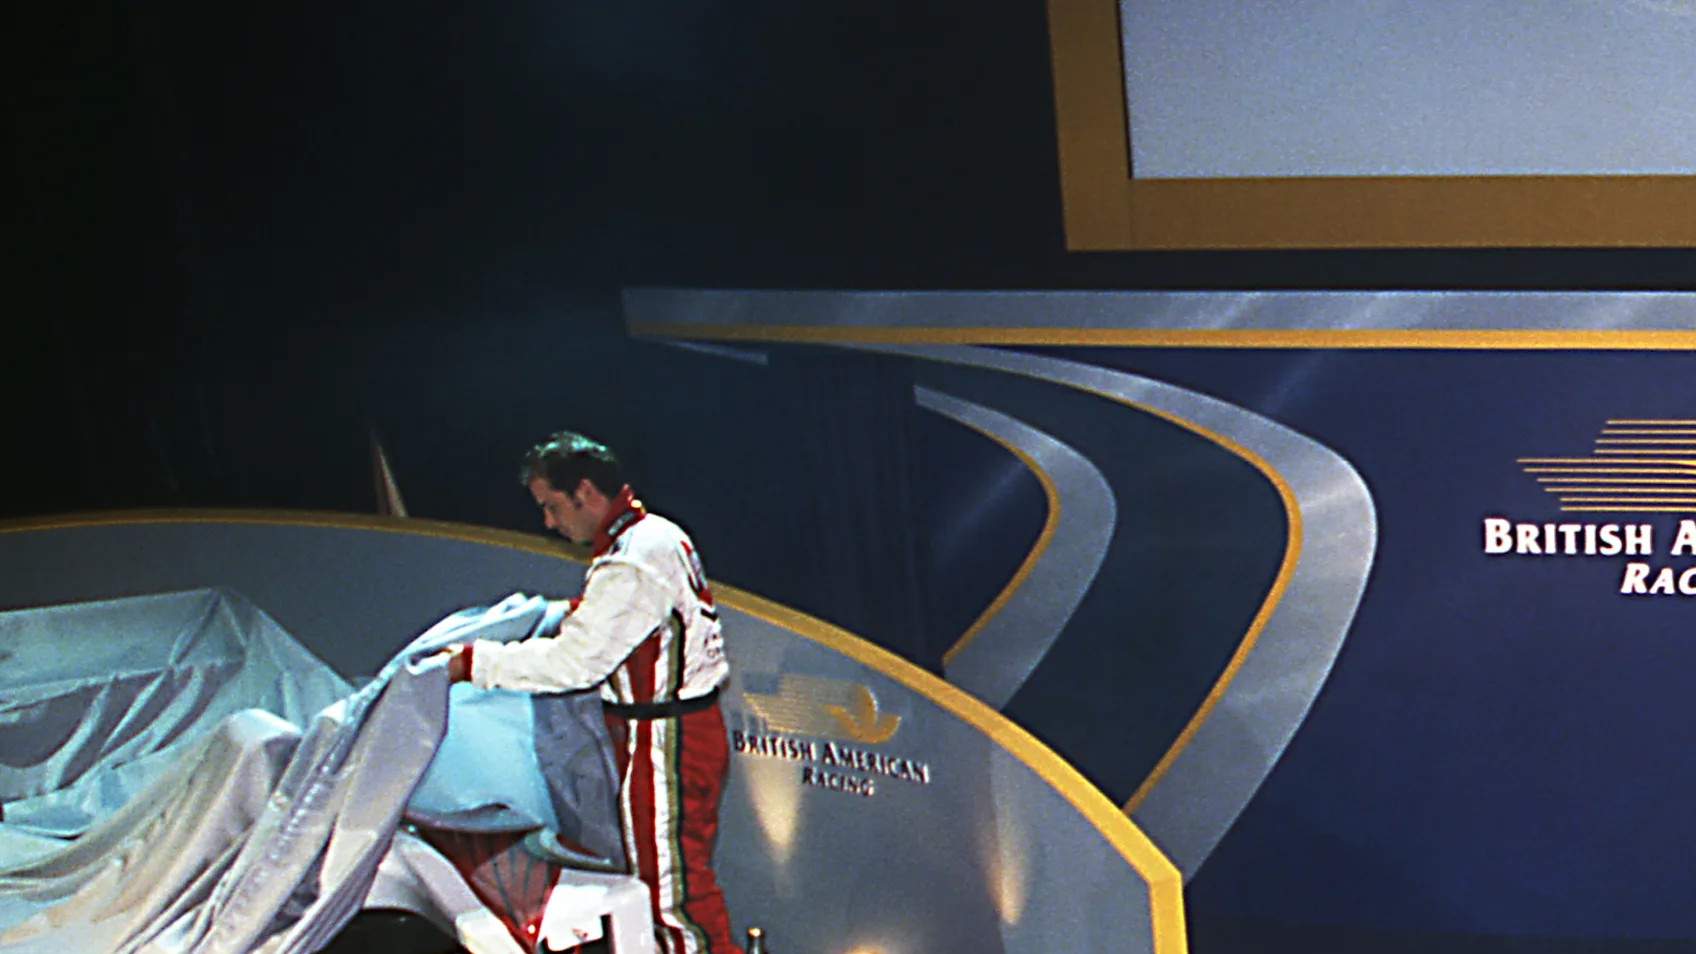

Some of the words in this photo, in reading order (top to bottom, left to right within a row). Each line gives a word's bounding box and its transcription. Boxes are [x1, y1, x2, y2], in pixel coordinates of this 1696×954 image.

[1483, 518, 1653, 556] BRITISH
[732, 728, 817, 763] BRITISH
[821, 741, 930, 785] AMERICAN
[802, 765, 875, 797] RACING
